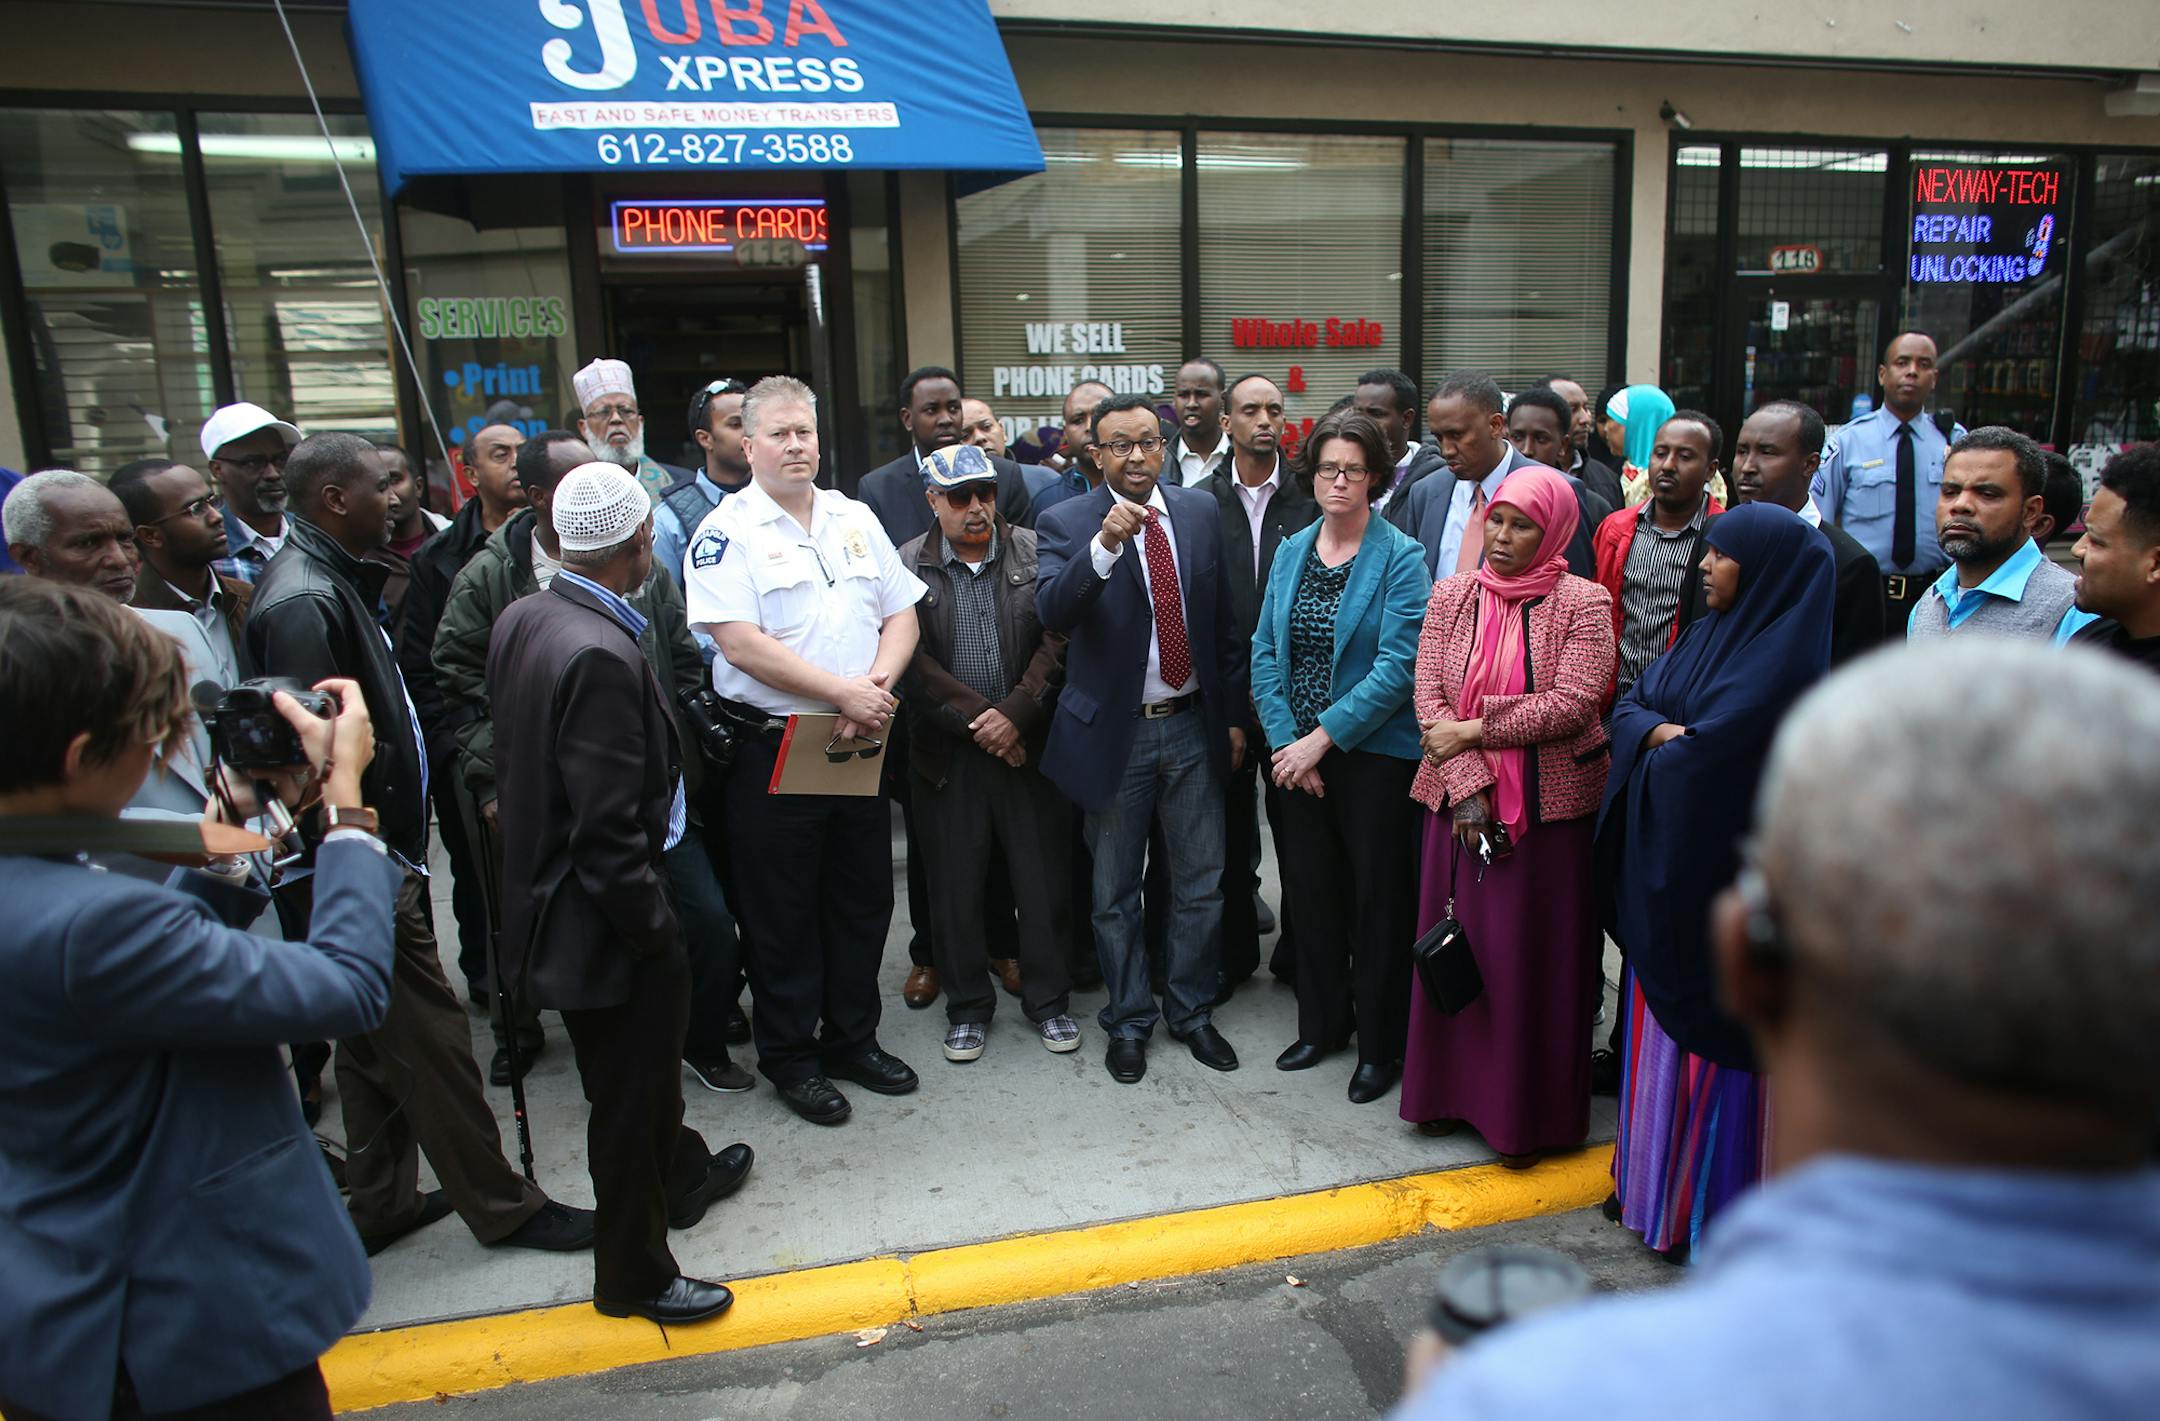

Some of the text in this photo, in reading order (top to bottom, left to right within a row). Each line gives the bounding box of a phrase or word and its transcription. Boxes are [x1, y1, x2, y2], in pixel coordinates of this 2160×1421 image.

[658, 56, 865, 92] XPRESS
[536, 108, 894, 123] FAST AND SAFE MONEY TRANSFERS
[597, 133, 855, 164] 612-827-3588
[1917, 168, 2060, 205] NEXWAY-TECH
[623, 207, 728, 244] PHONE
[1913, 214, 1993, 243] REPAIR
[1910, 254, 2027, 283] UNLOCKING
[418, 297, 567, 339] SERVICES
[1231, 316, 1383, 347] Whole Sale
[1025, 322, 1126, 354] WE SELL
[461, 362, 543, 396] Print
[1286, 365, 1309, 393] &
[696, 556, 718, 568] POLICE
